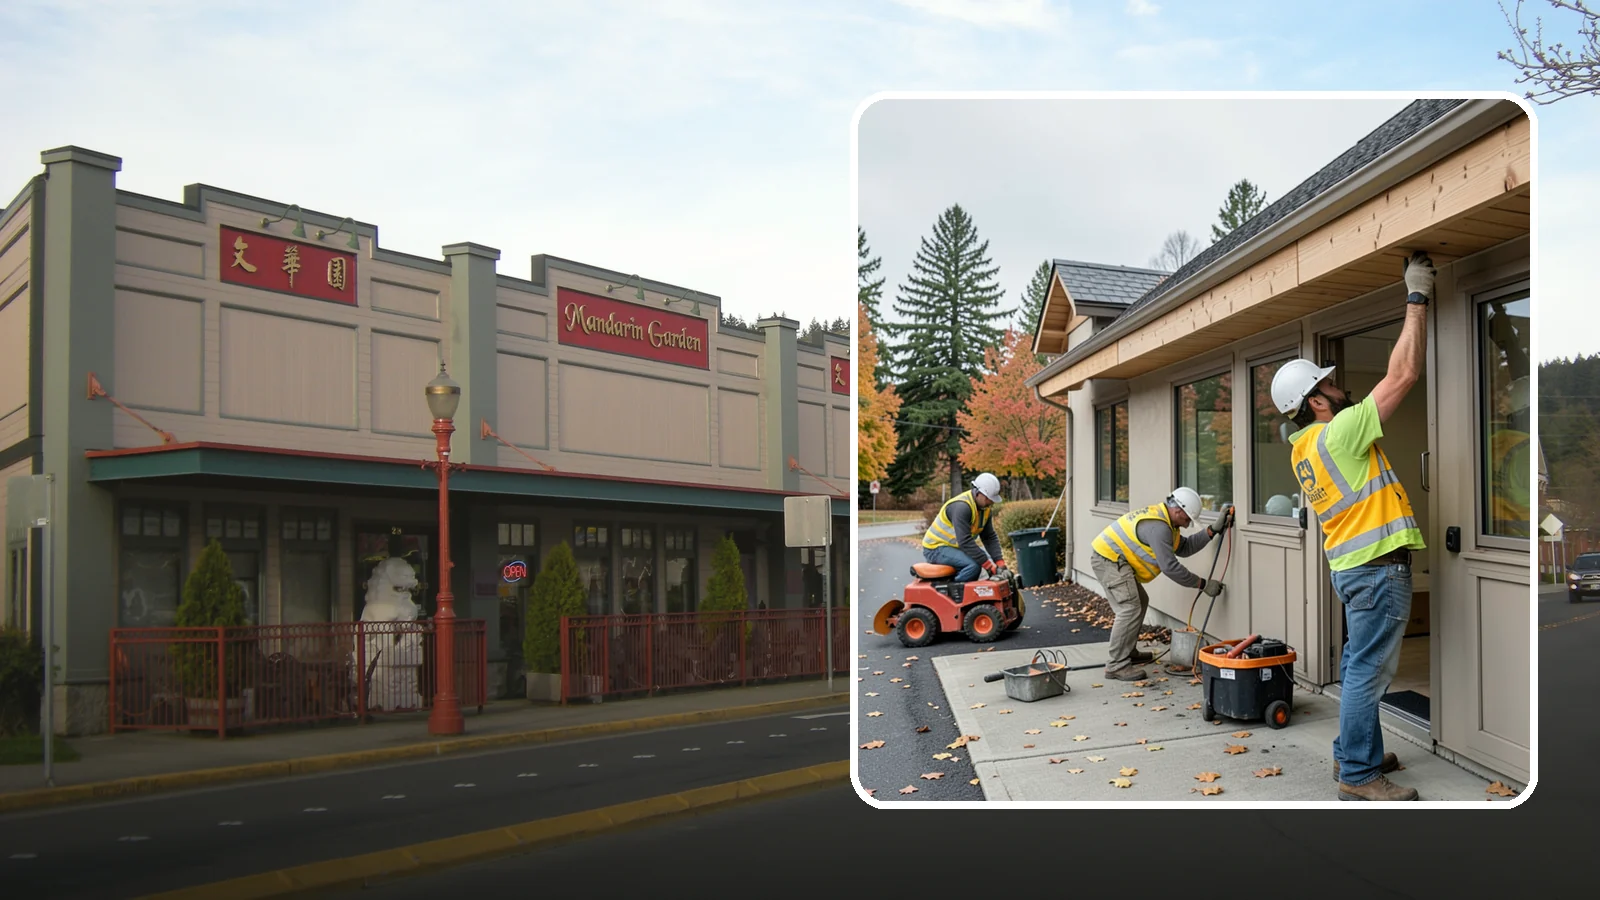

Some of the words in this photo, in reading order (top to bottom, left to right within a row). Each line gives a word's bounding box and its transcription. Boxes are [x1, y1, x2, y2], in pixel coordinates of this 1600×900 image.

[230, 235, 347, 291] 文華園
[564, 302, 644, 342] Mandarin
[647, 320, 702, 352] Garden
[503, 565, 527, 578] OPEN
